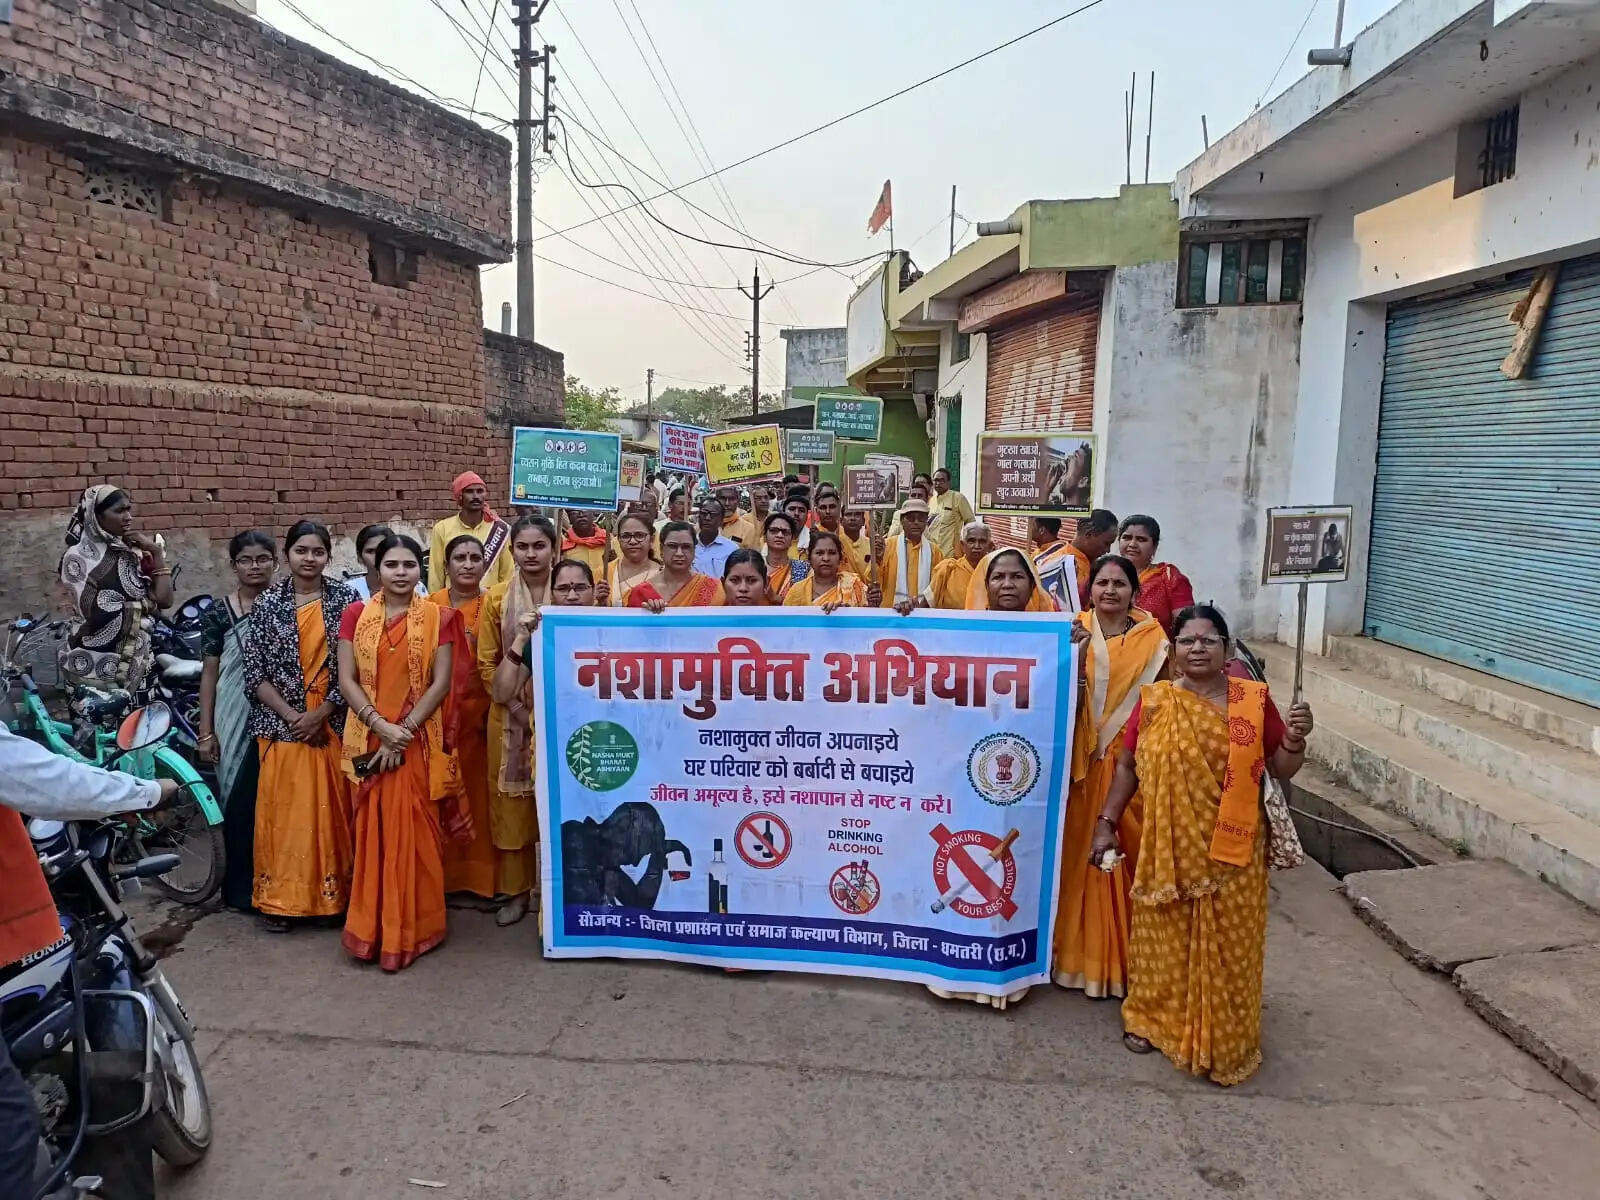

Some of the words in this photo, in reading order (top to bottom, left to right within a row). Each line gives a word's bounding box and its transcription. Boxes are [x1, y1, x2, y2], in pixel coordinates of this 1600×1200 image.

[997, 444, 1018, 458] गुटखा
[556, 457, 567, 470] हित
[568, 461, 586, 472] कदम
[997, 458, 1012, 469] गाल
[1001, 471, 1019, 483] अपनी
[996, 487, 1009, 499] खुद
[574, 636, 810, 720] नशामुक्ति
[823, 638, 1036, 709] अभियान
[698, 727, 771, 752] नशामुक्त
[775, 725, 822, 750] जीवन
[826, 728, 899, 754] अपनाइये
[684, 758, 706, 777] घर
[710, 756, 761, 778] परिवार
[766, 755, 788, 779] को
[792, 755, 836, 781] बर्बादी
[840, 758, 856, 781] से
[861, 760, 915, 786] बचाइये
[650, 784, 689, 802] जीवन
[694, 788, 738, 808] अमूल्य
[742, 785, 759, 806] है,
[762, 786, 786, 806] इसे
[790, 788, 846, 807] नशापान
[850, 789, 865, 808] से
[868, 794, 896, 811] नष्ट
[899, 796, 911, 812] न
[840, 818, 871, 829] STOP
[828, 829, 883, 843] DRINKING
[828, 843, 884, 856] ALCOHOL
[936, 855, 946, 875] NOT
[941, 833, 981, 856] SMOKING
[957, 901, 983, 915] YOUR
[985, 896, 1006, 914] BEST
[578, 910, 622, 928] सौजन्य
[640, 914, 671, 933] जिला
[675, 920, 722, 937] प्रशासन
[725, 919, 745, 938] एवं
[748, 924, 788, 940] समाज
[791, 926, 840, 943] कल्याण
[843, 926, 888, 949] विभाग,
[892, 931, 929, 951] जिला
[940, 940, 984, 961] धमतरी
[21, 933, 72, 967] HONDA
